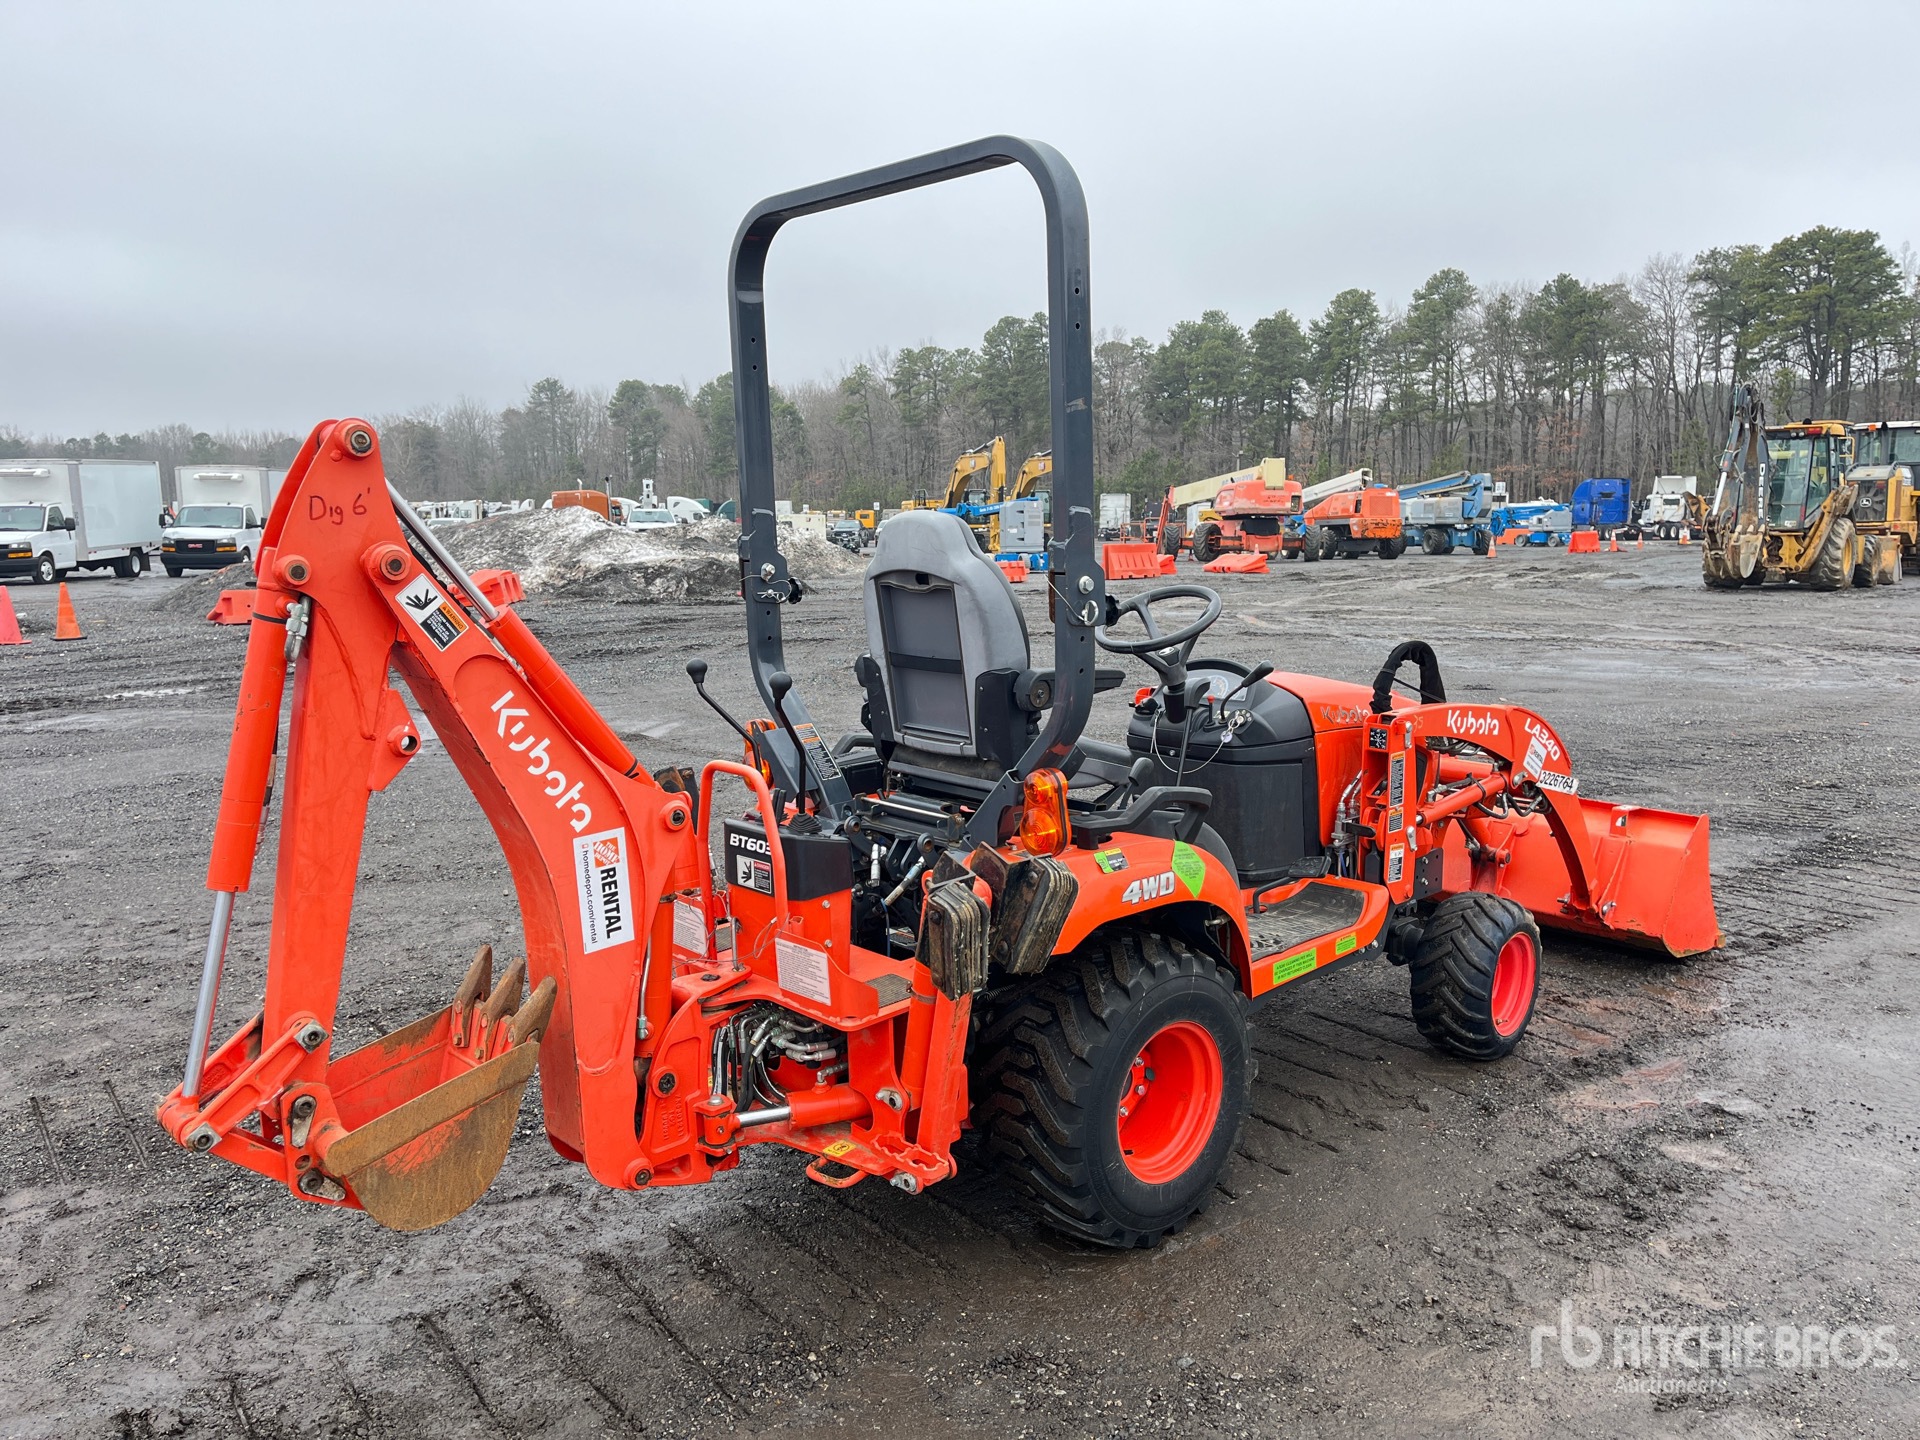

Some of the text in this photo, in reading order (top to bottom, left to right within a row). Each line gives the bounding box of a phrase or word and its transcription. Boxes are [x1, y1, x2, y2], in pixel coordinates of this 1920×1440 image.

[309, 495, 344, 525] Dig
[445, 609, 464, 630] WARNING
[1320, 705, 1370, 724] Kubota
[1447, 709, 1499, 736] Kubota
[1524, 717, 1561, 761] LA340
[490, 690, 592, 833] Kubota
[1540, 771, 1575, 790] 3226764
[593, 841, 620, 863] HOME
[594, 852, 612, 866] DEPOT
[606, 842, 616, 851] THE
[582, 850, 598, 943] homedepot.com/rental
[1121, 871, 1175, 905] 4WD
[600, 867, 622, 939] RENTAL
